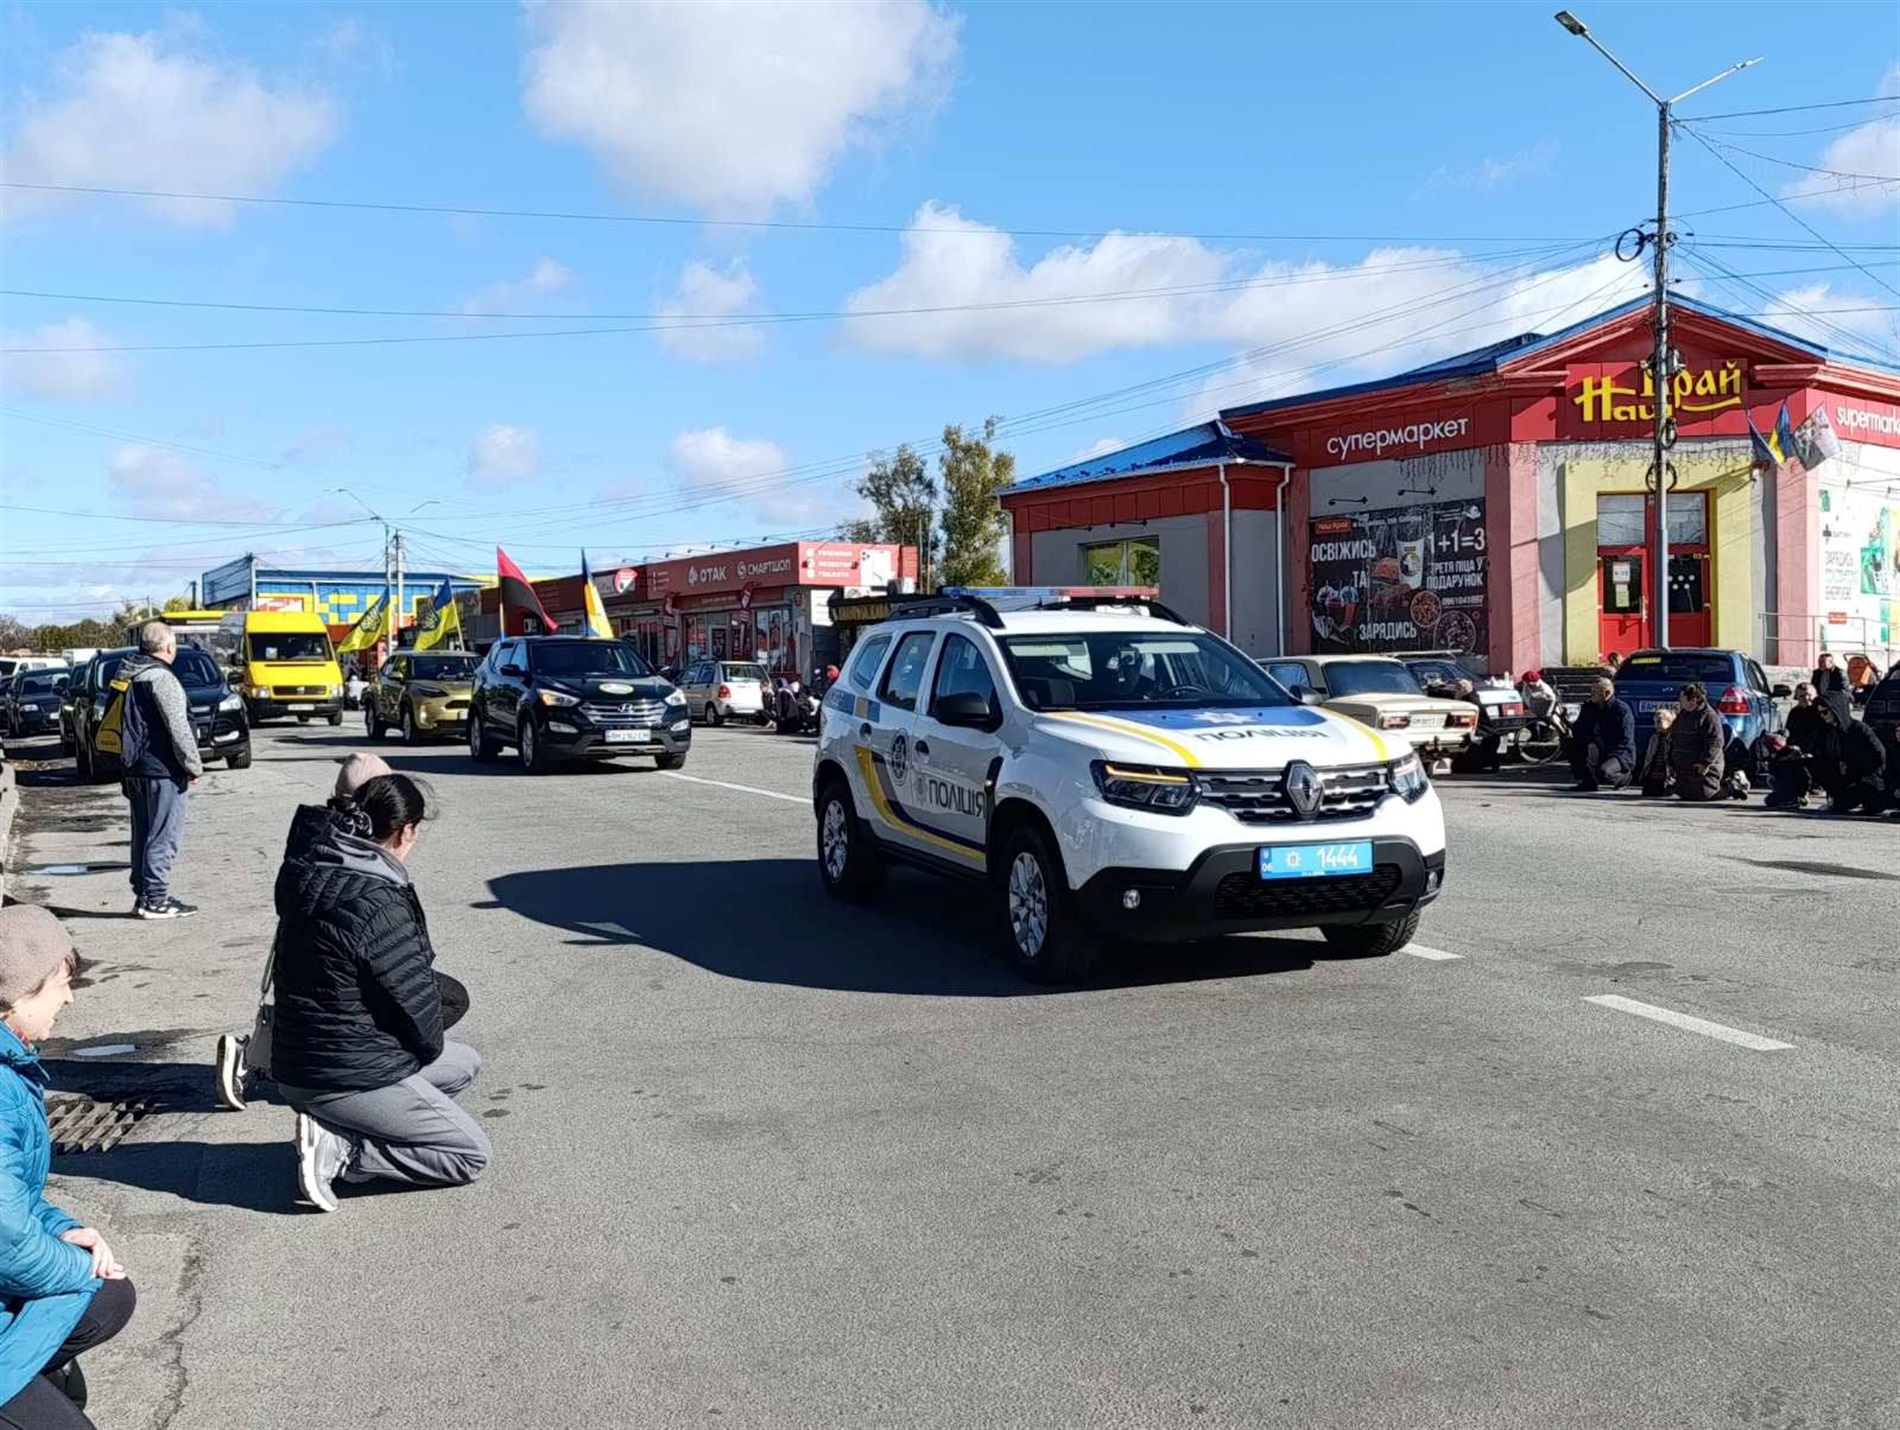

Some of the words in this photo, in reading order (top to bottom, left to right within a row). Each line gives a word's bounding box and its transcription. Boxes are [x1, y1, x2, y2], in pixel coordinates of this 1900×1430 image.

[1327, 418, 1469, 460] супермаркет
[1311, 539, 1377, 563] ОСВІЖИСЬ
[1427, 527, 1486, 556] 1+1=3
[700, 566, 727, 582] ОТАК
[748, 559, 791, 576] СМАРТШОП
[1352, 571, 1367, 589] ТА
[1426, 572, 1484, 590] ПОДАРУНОК
[1359, 620, 1418, 641] ЗАРЯДИСЬ
[1194, 728, 1330, 742] ПОЛІЦІЯ
[929, 778, 985, 818] ПОЛІЦІЯ
[1316, 845, 1359, 870] 1444
[1261, 862, 1274, 873] 06
